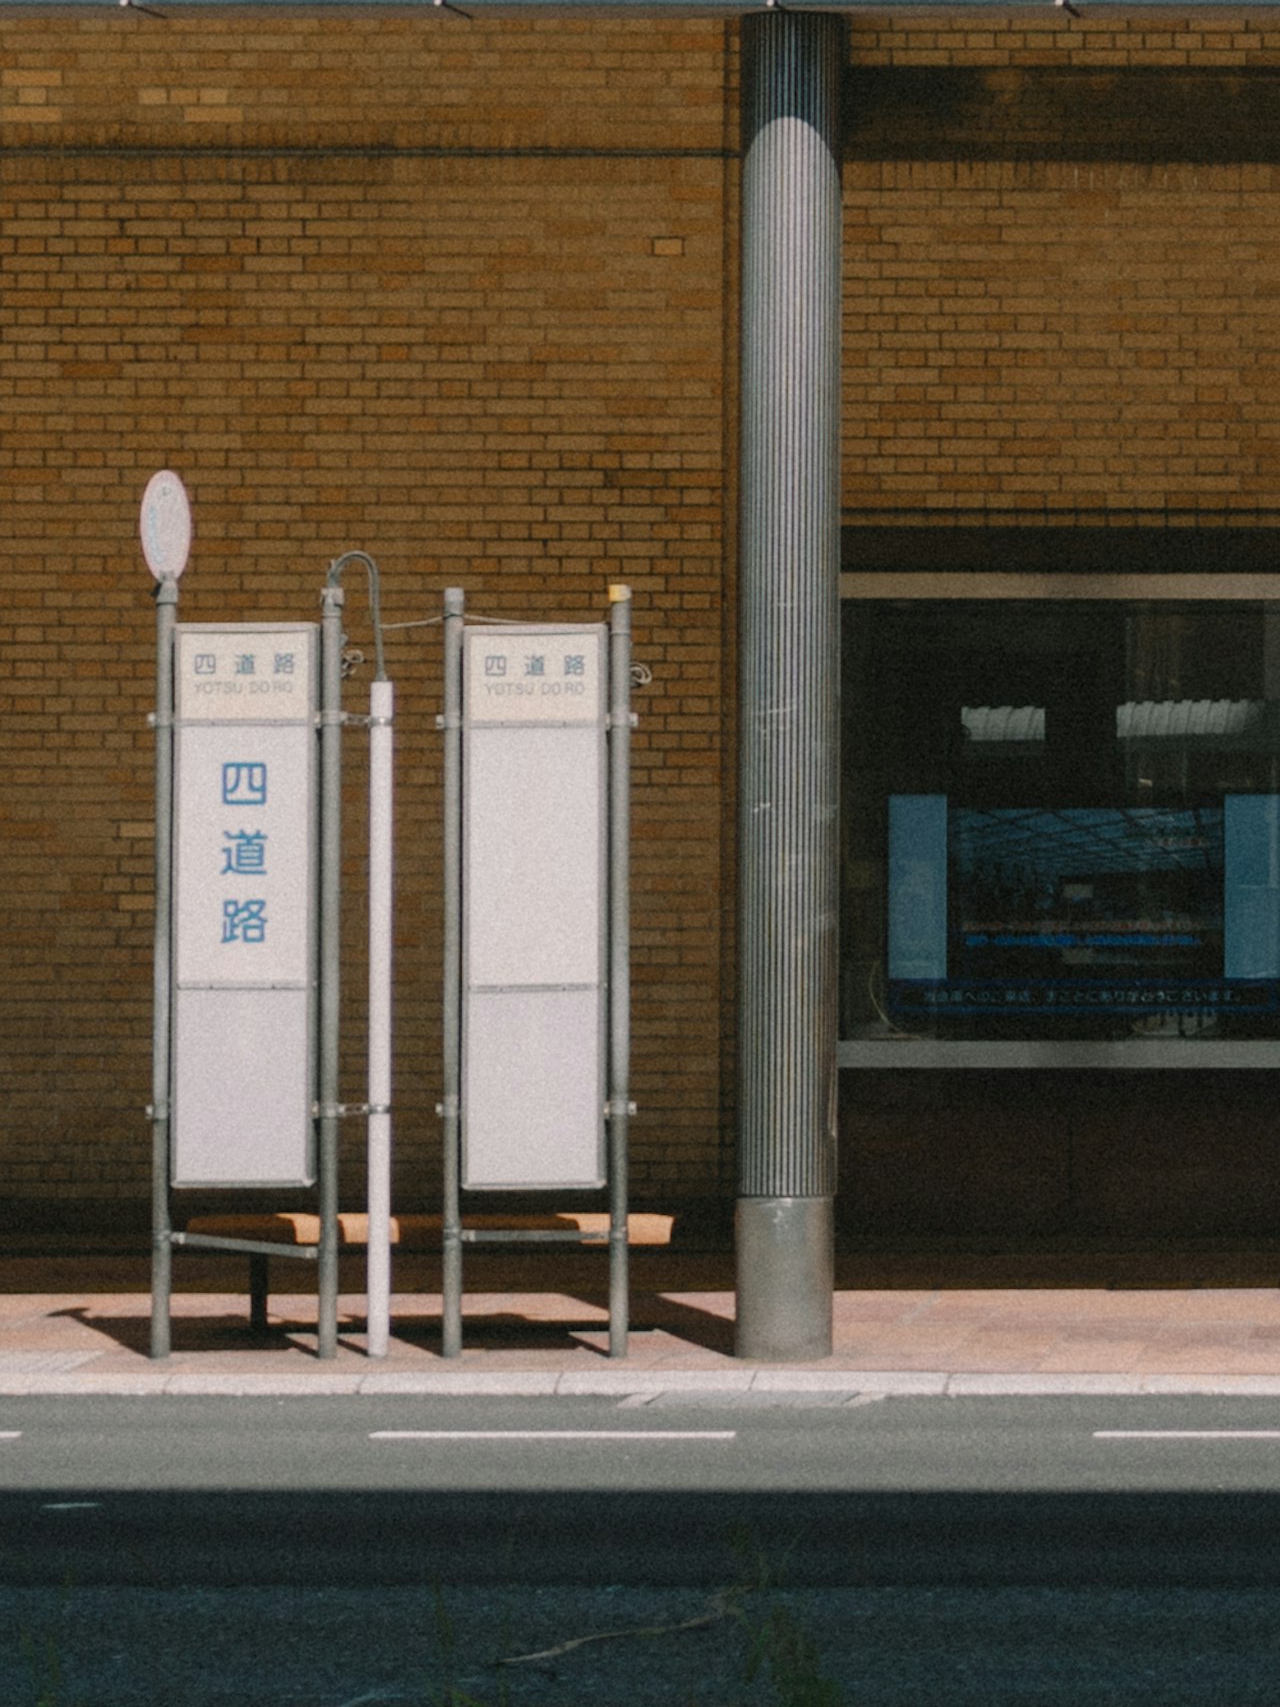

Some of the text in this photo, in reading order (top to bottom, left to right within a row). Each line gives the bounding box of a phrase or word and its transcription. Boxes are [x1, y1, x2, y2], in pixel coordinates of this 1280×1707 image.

[194, 653, 295, 675] 四道路
[484, 654, 585, 676] 四道路
[194, 681, 243, 695] YOTSU
[485, 682, 534, 696] YOTSU
[220, 760, 268, 946] 四道路
